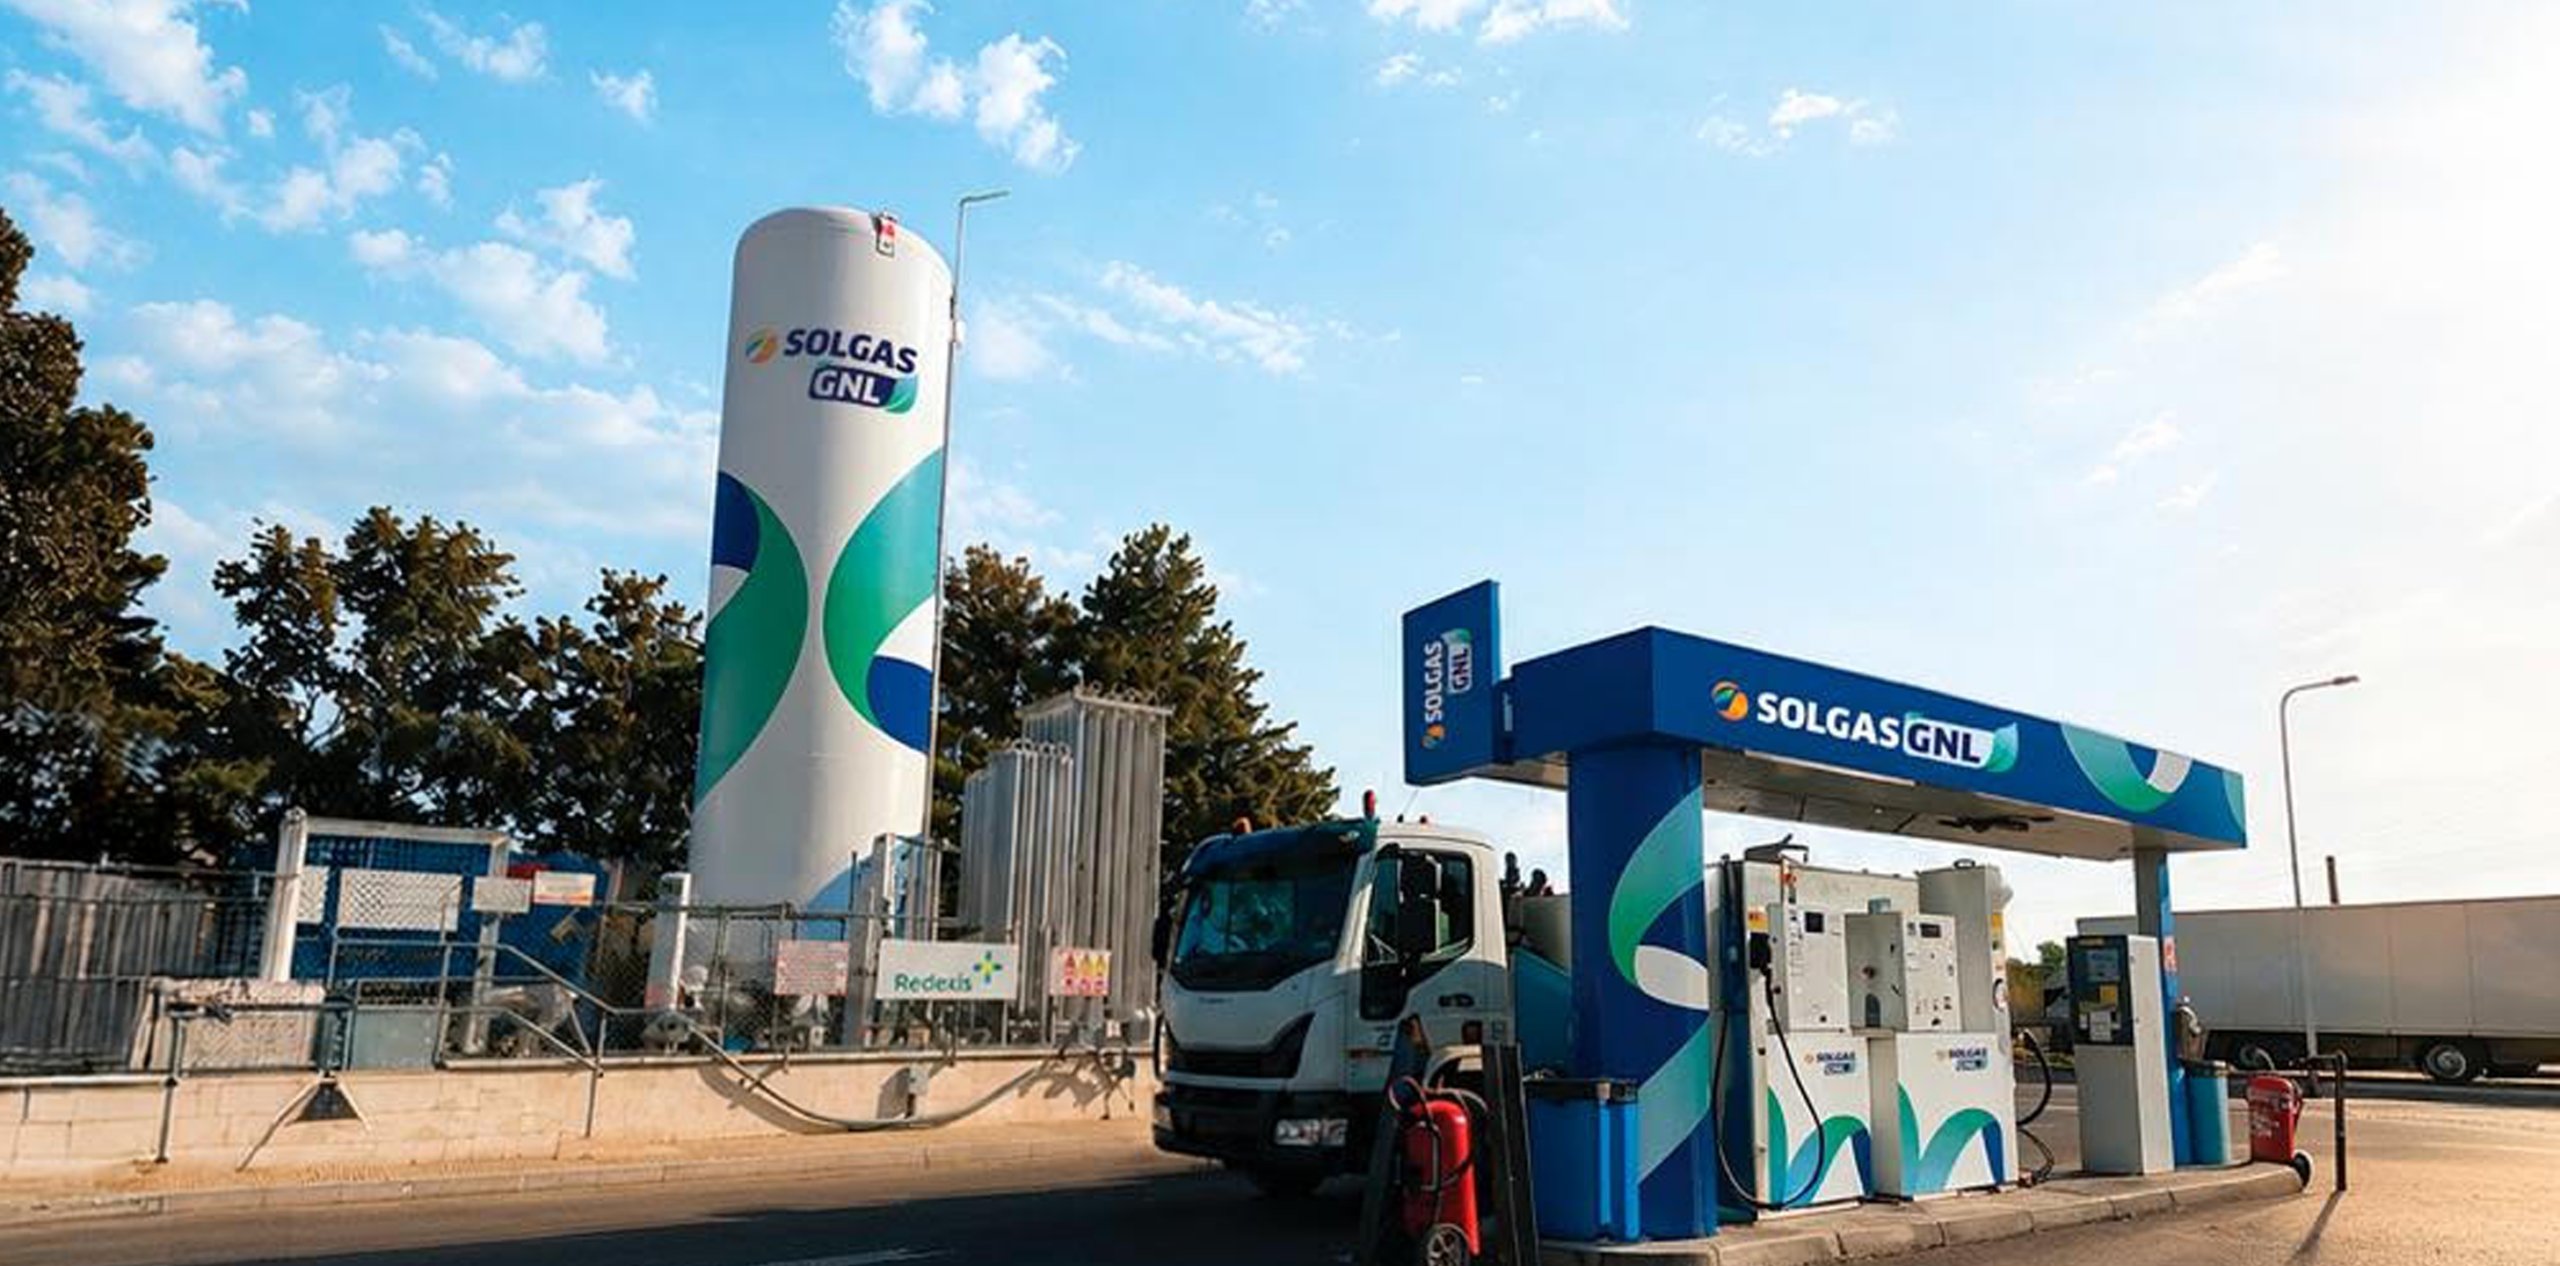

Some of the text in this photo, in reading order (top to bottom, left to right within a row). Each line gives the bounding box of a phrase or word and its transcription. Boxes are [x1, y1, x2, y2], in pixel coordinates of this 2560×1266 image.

[784, 329, 918, 373] SOLGAS
[815, 369, 881, 404] GNL
[1424, 641, 1442, 723] SOLGAS
[1452, 647, 1468, 691] GNL
[1757, 693, 1981, 764] SOLGAS GNL
[894, 973, 972, 992] Redexis
